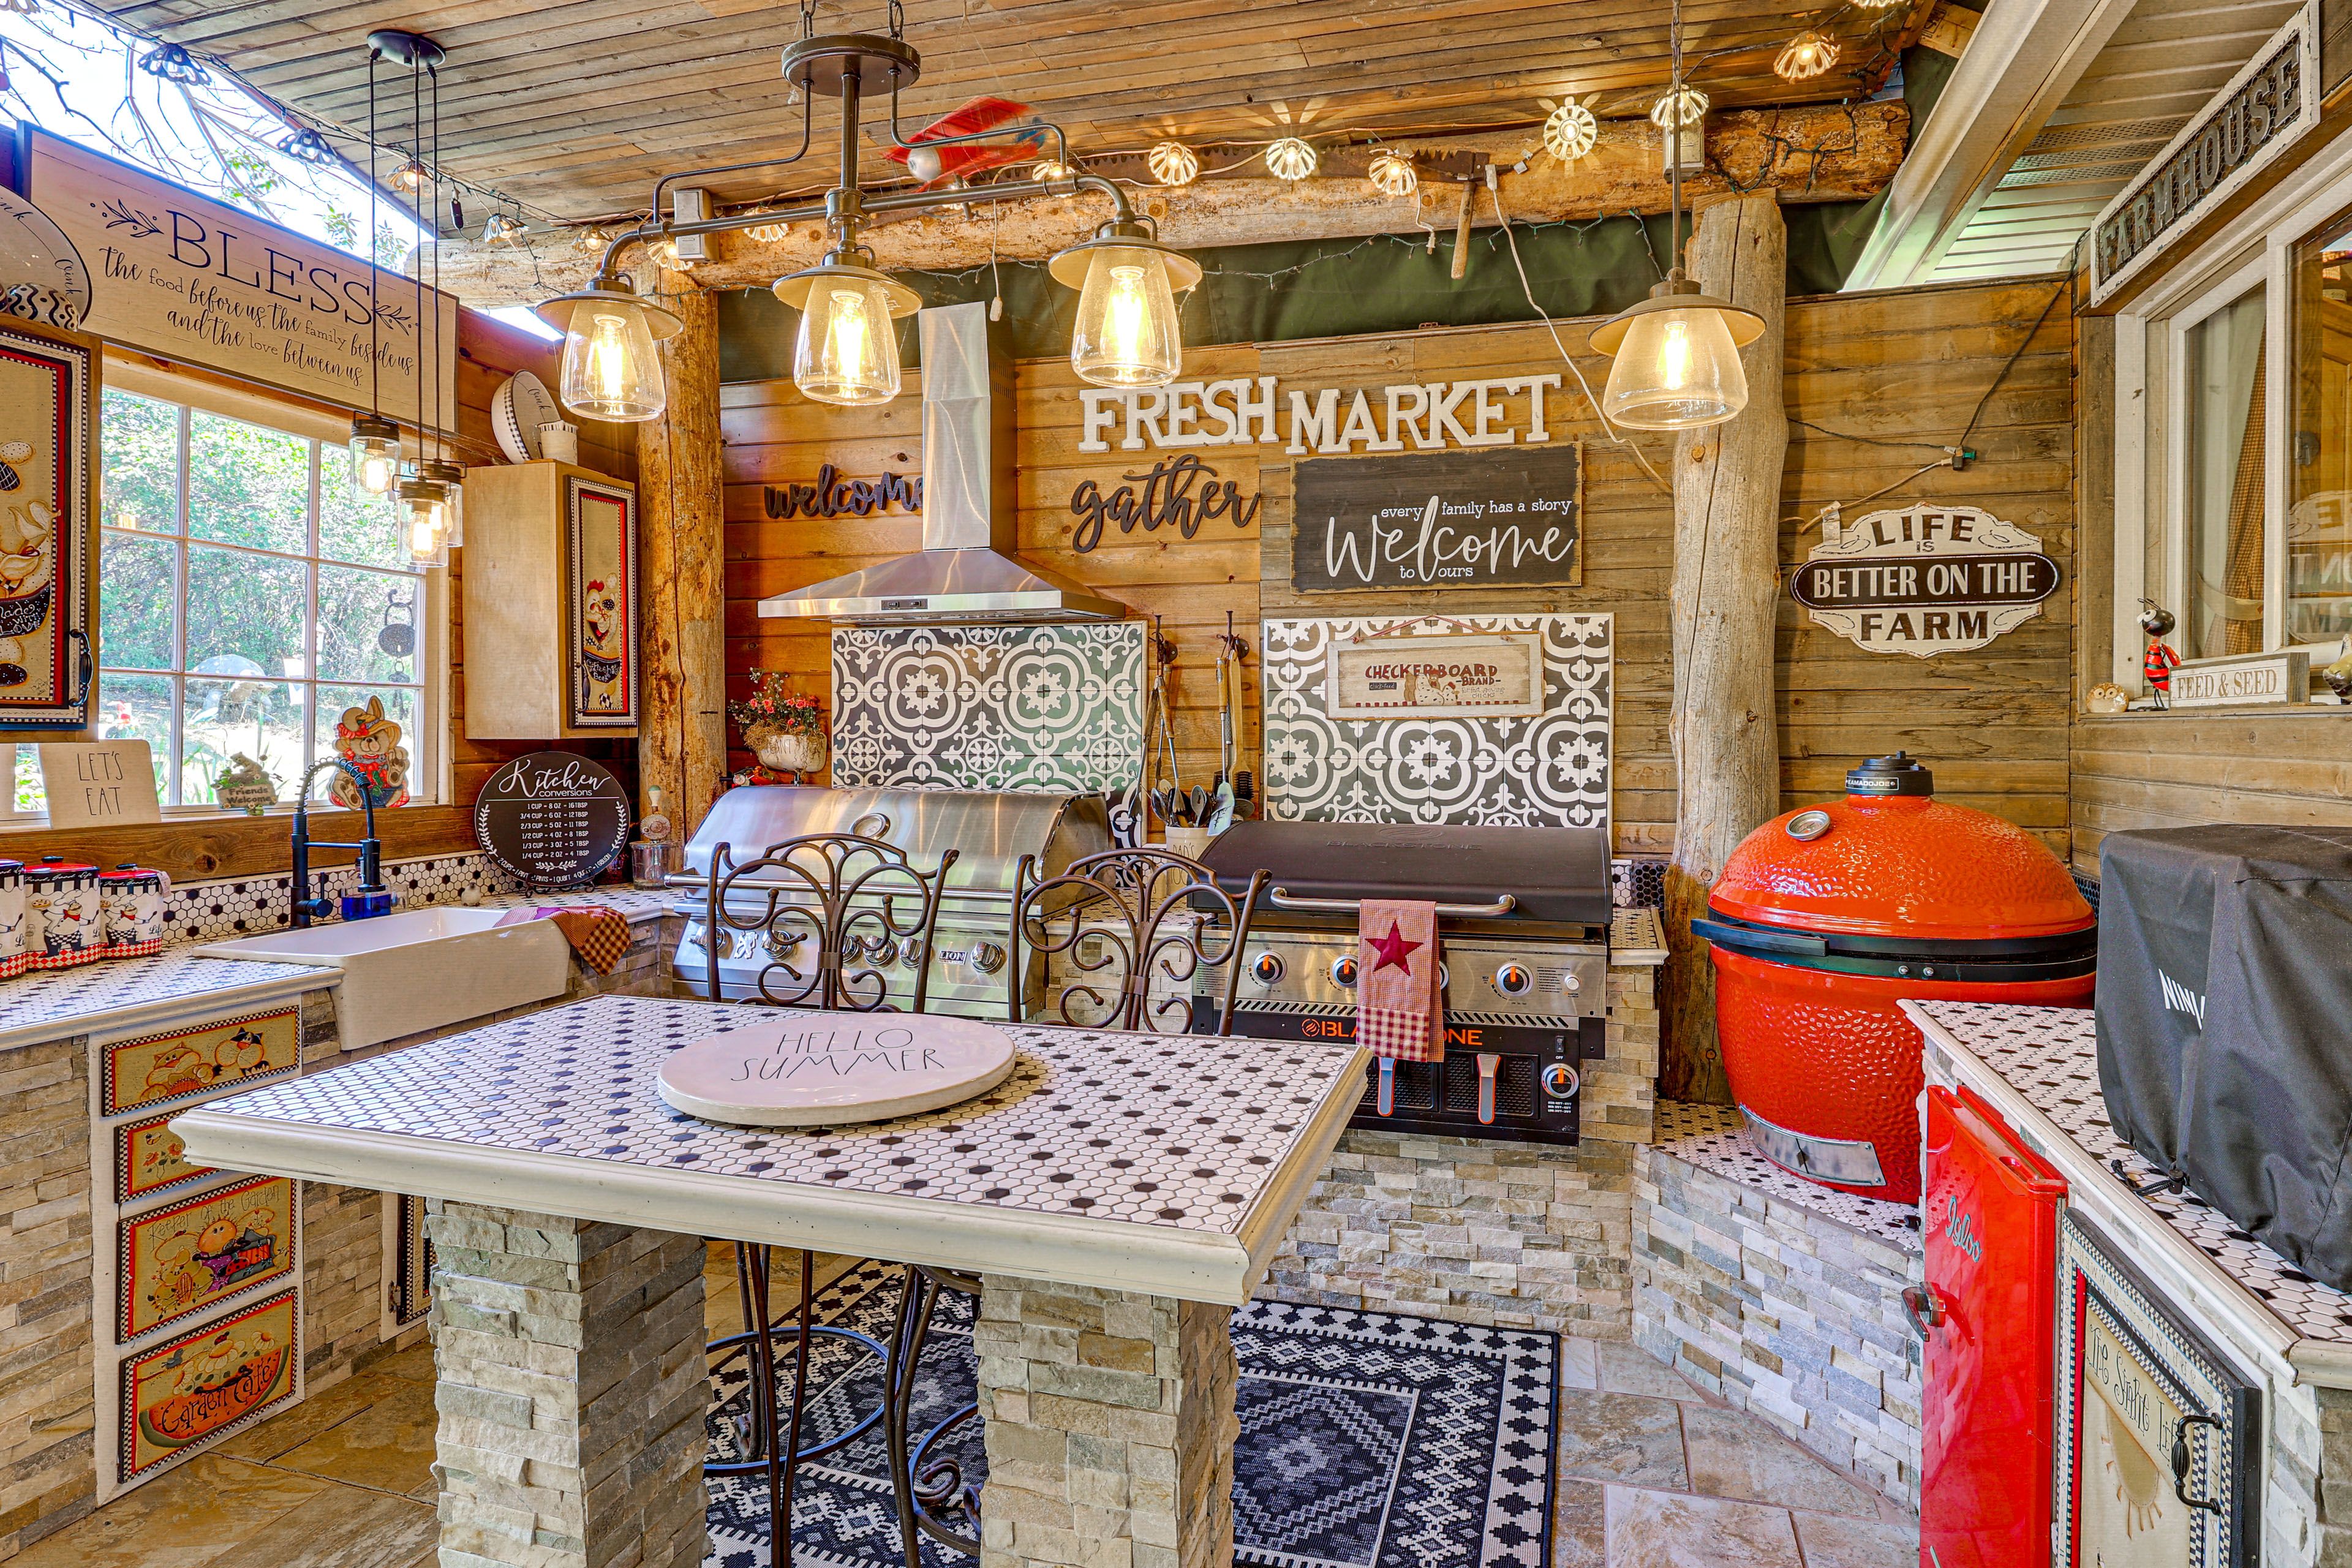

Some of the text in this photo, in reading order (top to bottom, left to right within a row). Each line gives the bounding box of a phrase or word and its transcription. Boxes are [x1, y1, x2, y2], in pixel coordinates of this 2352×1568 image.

[2101, 44, 2300, 281] FARMHOUSE
[55, 258, 82, 296] Oink
[166, 209, 372, 325] BLESS
[99, 246, 142, 280] the
[149, 268, 184, 294] food
[189, 278, 244, 317] before
[267, 303, 301, 332] the
[305, 320, 347, 351] family
[398, 356, 413, 376] us
[167, 309, 210, 339] and
[208, 316, 244, 346] the
[249, 332, 278, 355] love
[284, 339, 345, 377] between
[527, 388, 552, 410] Oink
[1079, 374, 1561, 454] FRESH MARKET
[1070, 453, 1260, 554] gather
[1381, 499, 1572, 522] every family has a story
[1325, 496, 1574, 582] Welcome
[1871, 514, 1976, 547] LIFE
[1916, 541, 1934, 552] IS
[1400, 565, 1473, 578] to ours
[1814, 562, 2036, 598] BETTER ON THE
[1860, 611, 1988, 641] FARM
[2177, 669, 2277, 699] FEED & SEED
[77, 751, 123, 780] LET'S
[499, 759, 611, 797] Kitchen
[86, 788, 121, 815] EAT
[228, 787, 268, 796] Friends
[538, 788, 592, 797] conversions
[1327, 840, 1482, 850] BLACKSTONE
[502, 861, 514, 870] CUPS
[940, 951, 965, 960] LION
[777, 1028, 913, 1055] HELLO
[731, 1048, 944, 1082] SUMMER
[1945, 1195, 1983, 1263] Igloo
